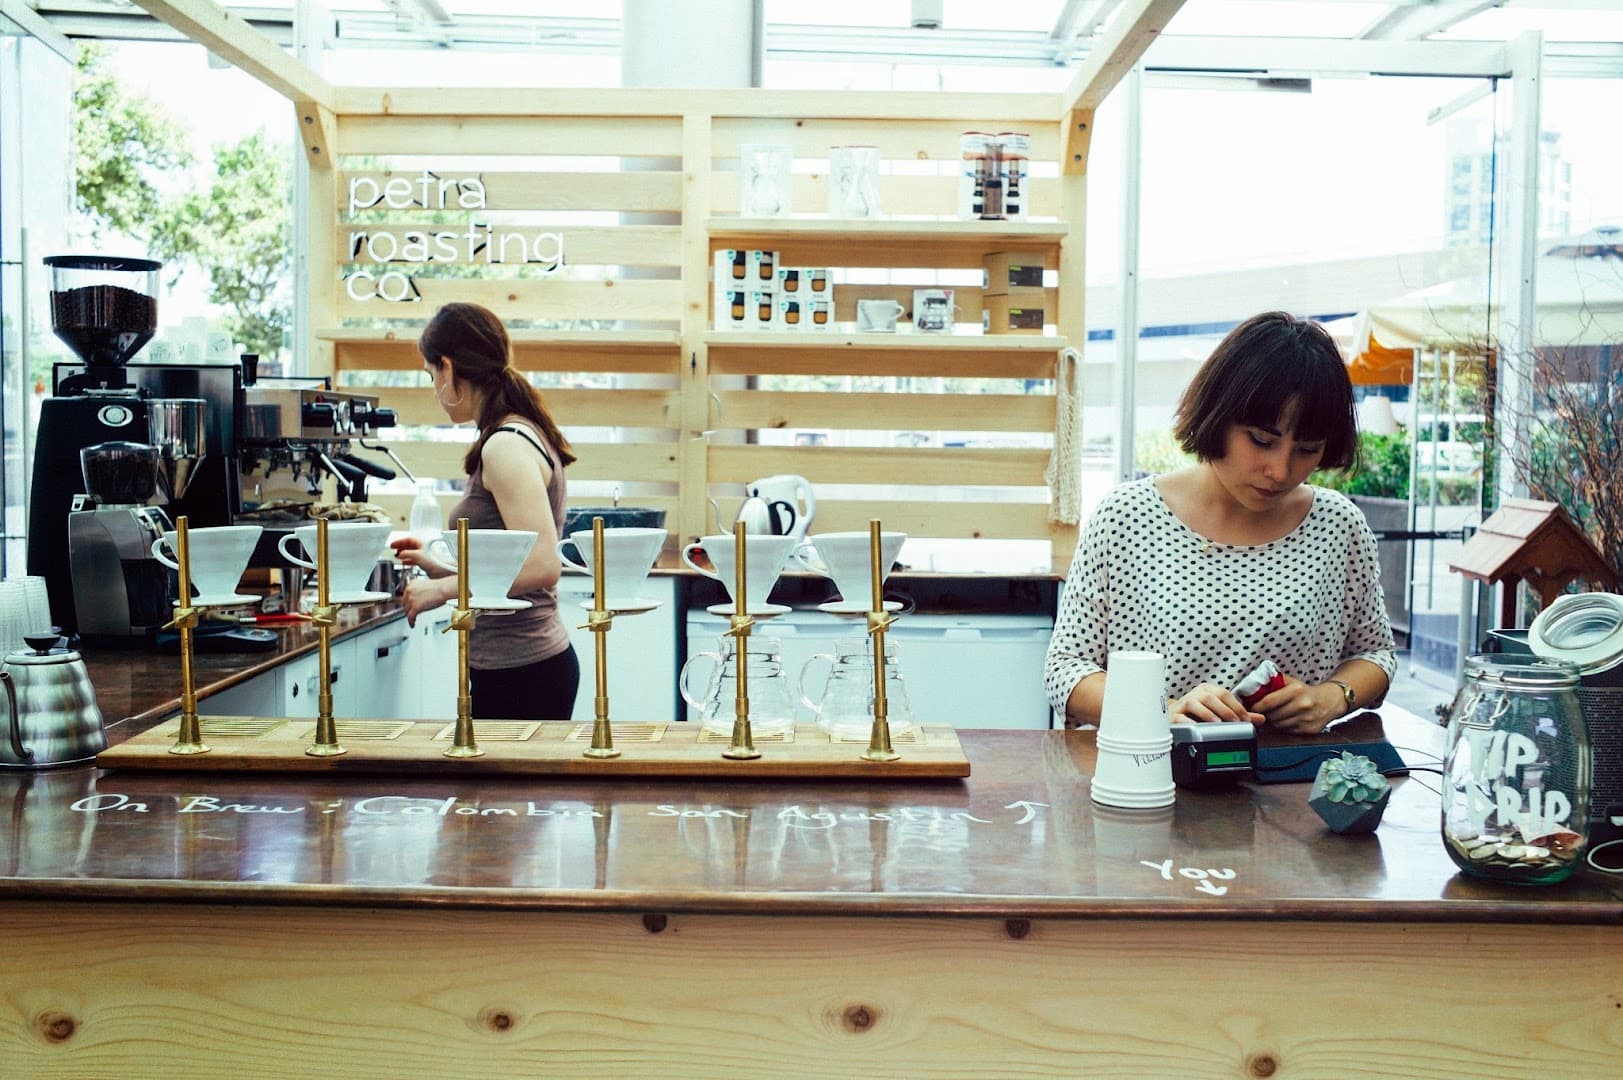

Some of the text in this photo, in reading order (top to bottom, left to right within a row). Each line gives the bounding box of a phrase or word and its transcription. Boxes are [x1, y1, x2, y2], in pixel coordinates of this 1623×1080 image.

[350, 170, 487, 219] petra
[350, 221, 564, 273] roasting
[346, 271, 421, 303] co.
[69, 793, 149, 813] On
[177, 795, 305, 814] Brew
[354, 795, 605, 818] Colombia
[647, 804, 749, 818] San
[776, 805, 993, 830] Agustin
[1139, 859, 1238, 881] You
